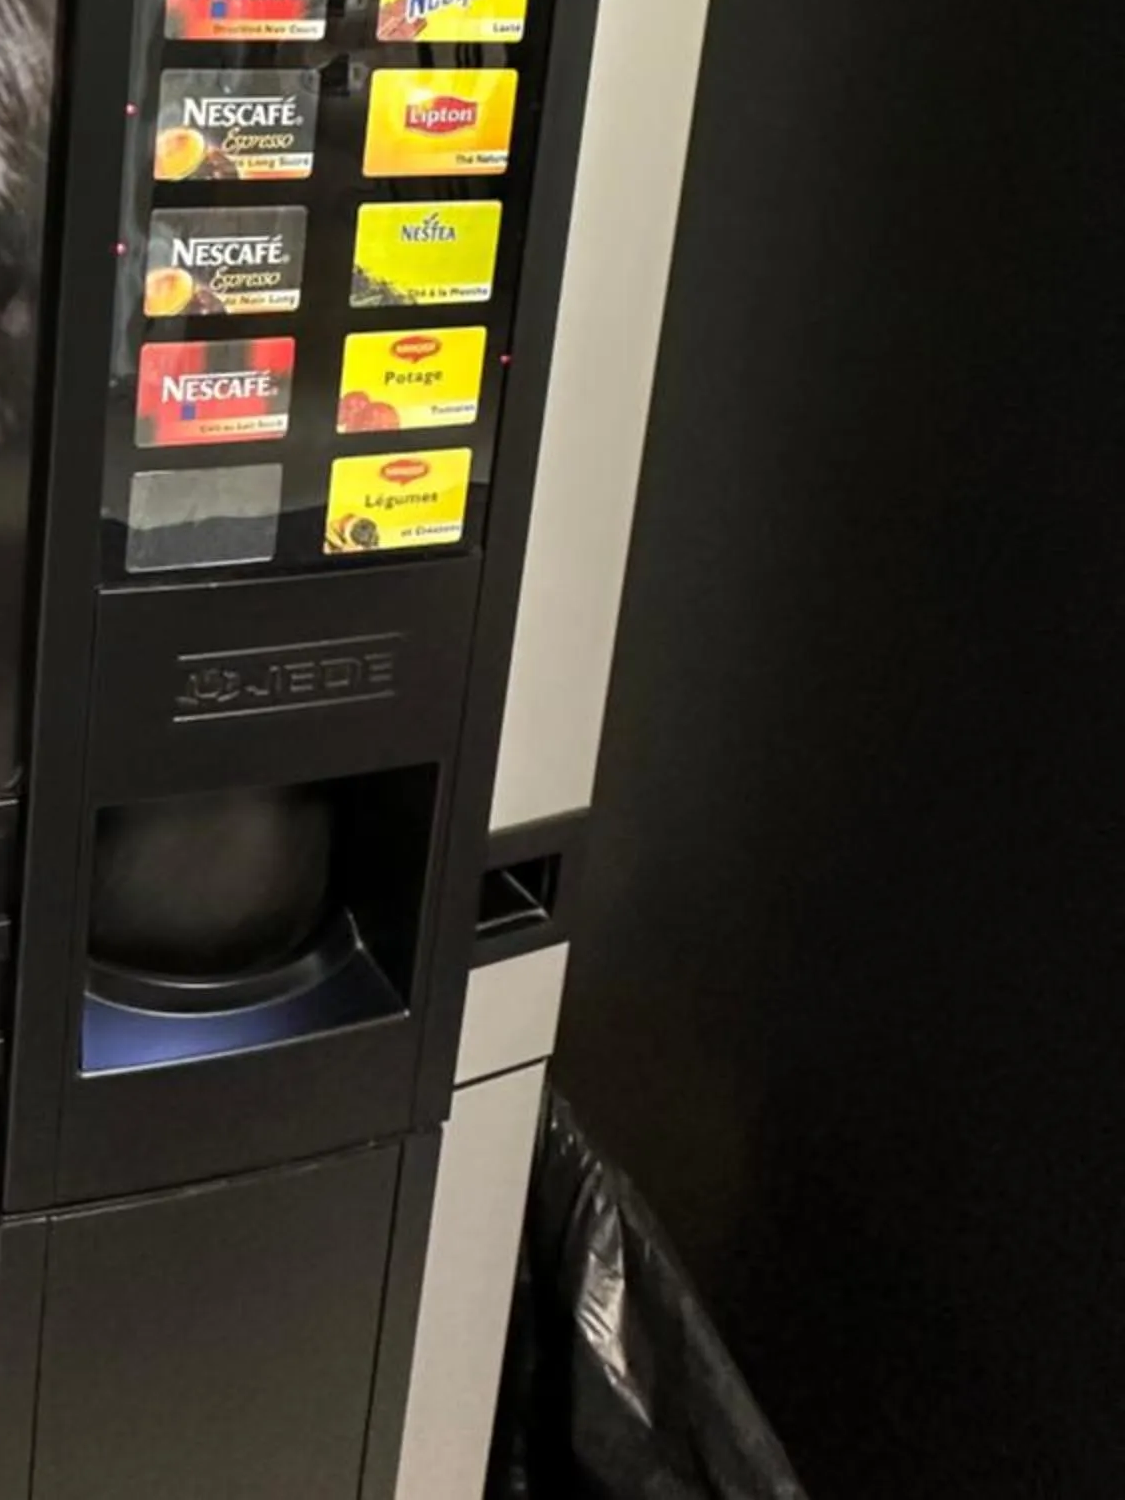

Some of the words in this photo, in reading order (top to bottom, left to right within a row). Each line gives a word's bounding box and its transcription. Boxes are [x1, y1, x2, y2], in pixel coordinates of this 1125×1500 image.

[183, 96, 297, 126] NESCAFÉ
[405, 104, 474, 125] Lipton
[221, 126, 293, 153] Espresso
[171, 235, 284, 267] NESCAFÉ
[210, 267, 282, 293] Espresso
[161, 370, 272, 403] NESCAFÉ
[383, 369, 443, 387] Potage
[364, 490, 439, 509] Légumes
